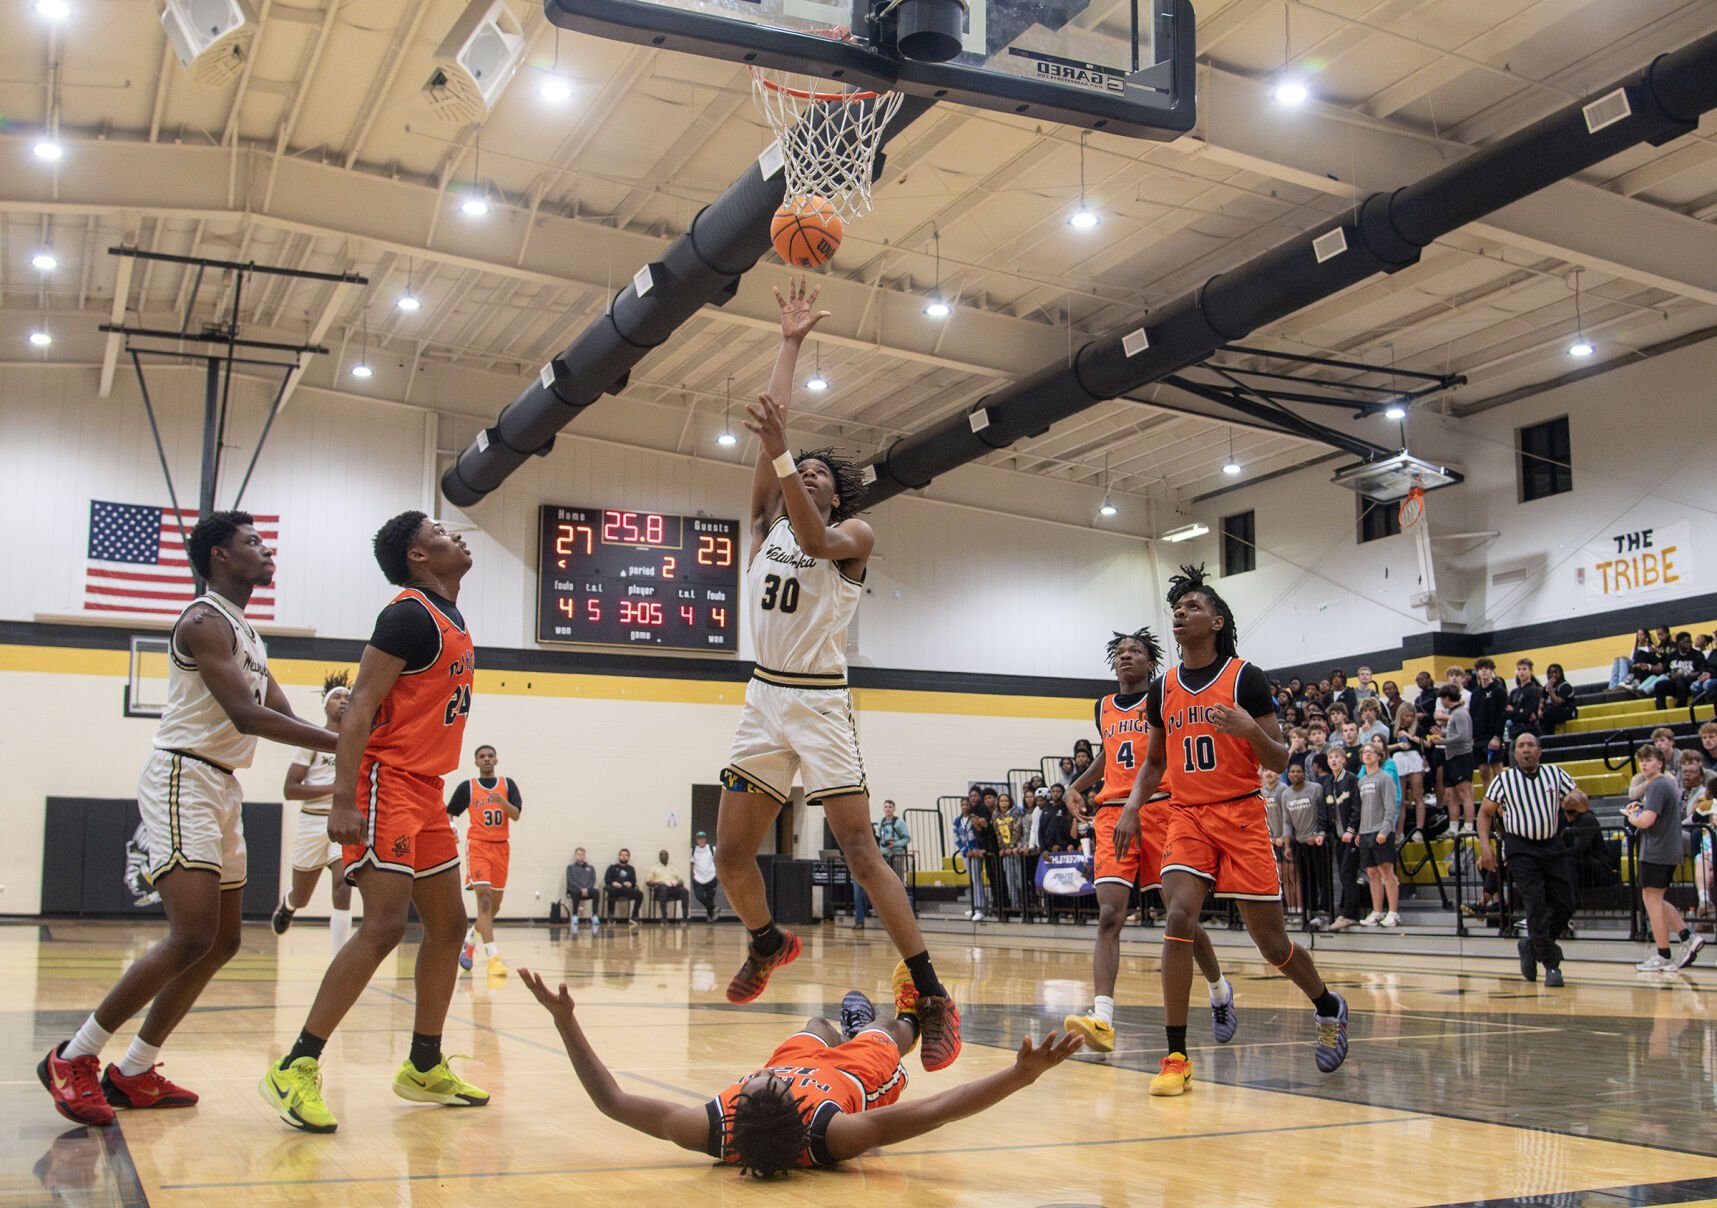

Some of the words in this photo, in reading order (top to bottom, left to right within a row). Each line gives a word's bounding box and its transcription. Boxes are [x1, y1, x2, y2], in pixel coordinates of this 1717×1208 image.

[558, 509, 585, 521] Home
[605, 511, 662, 543] 25.8
[694, 520, 729, 532] Guests
[557, 525, 592, 554] 27
[1613, 529, 1653, 554] THE
[698, 536, 731, 565] 23
[629, 565, 655, 577] period
[663, 556, 675, 578] 2
[1595, 546, 1680, 594] TRIBE
[553, 580, 574, 592] fouls
[628, 584, 655, 597] player
[707, 590, 726, 601] fouls
[762, 574, 800, 613] 30
[559, 598, 573, 618] 4
[587, 599, 600, 620] 5
[680, 605, 693, 625] 4
[712, 607, 725, 628] 4
[555, 626, 572, 635] won
[630, 630, 652, 641] game
[708, 635, 724, 644] won
[444, 684, 471, 727] 24
[1169, 709, 1184, 736] PJ
[1188, 705, 1217, 725] HIG
[1116, 740, 1135, 769] 4
[1183, 734, 1217, 773] 10
[483, 809, 503, 827] 30
